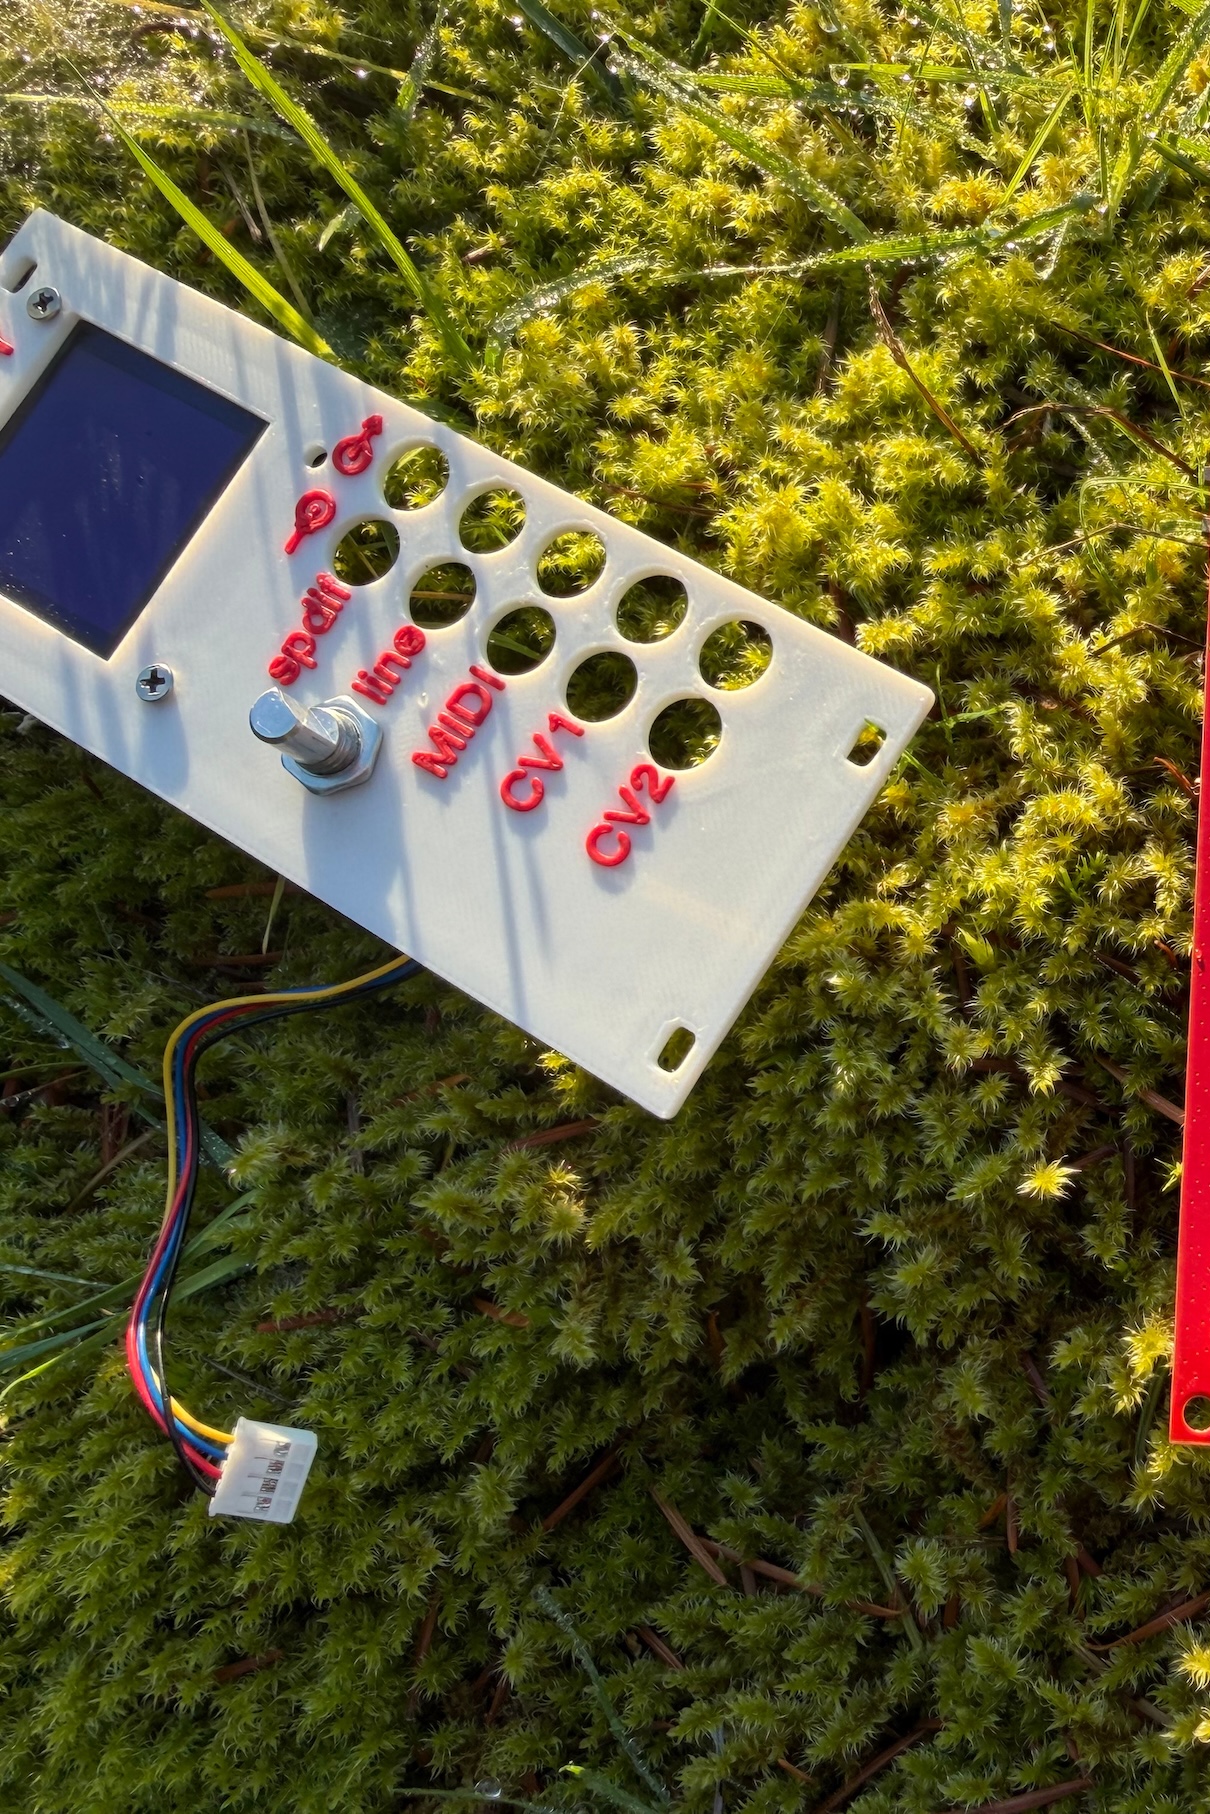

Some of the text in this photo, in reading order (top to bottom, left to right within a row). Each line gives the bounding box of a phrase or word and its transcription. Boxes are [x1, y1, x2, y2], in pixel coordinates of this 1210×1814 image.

[268, 572, 352, 686] spdif
[351, 625, 427, 706] line
[411, 665, 507, 779] MIDI
[499, 711, 586, 813] CV1
[585, 762, 676, 868] CV2
